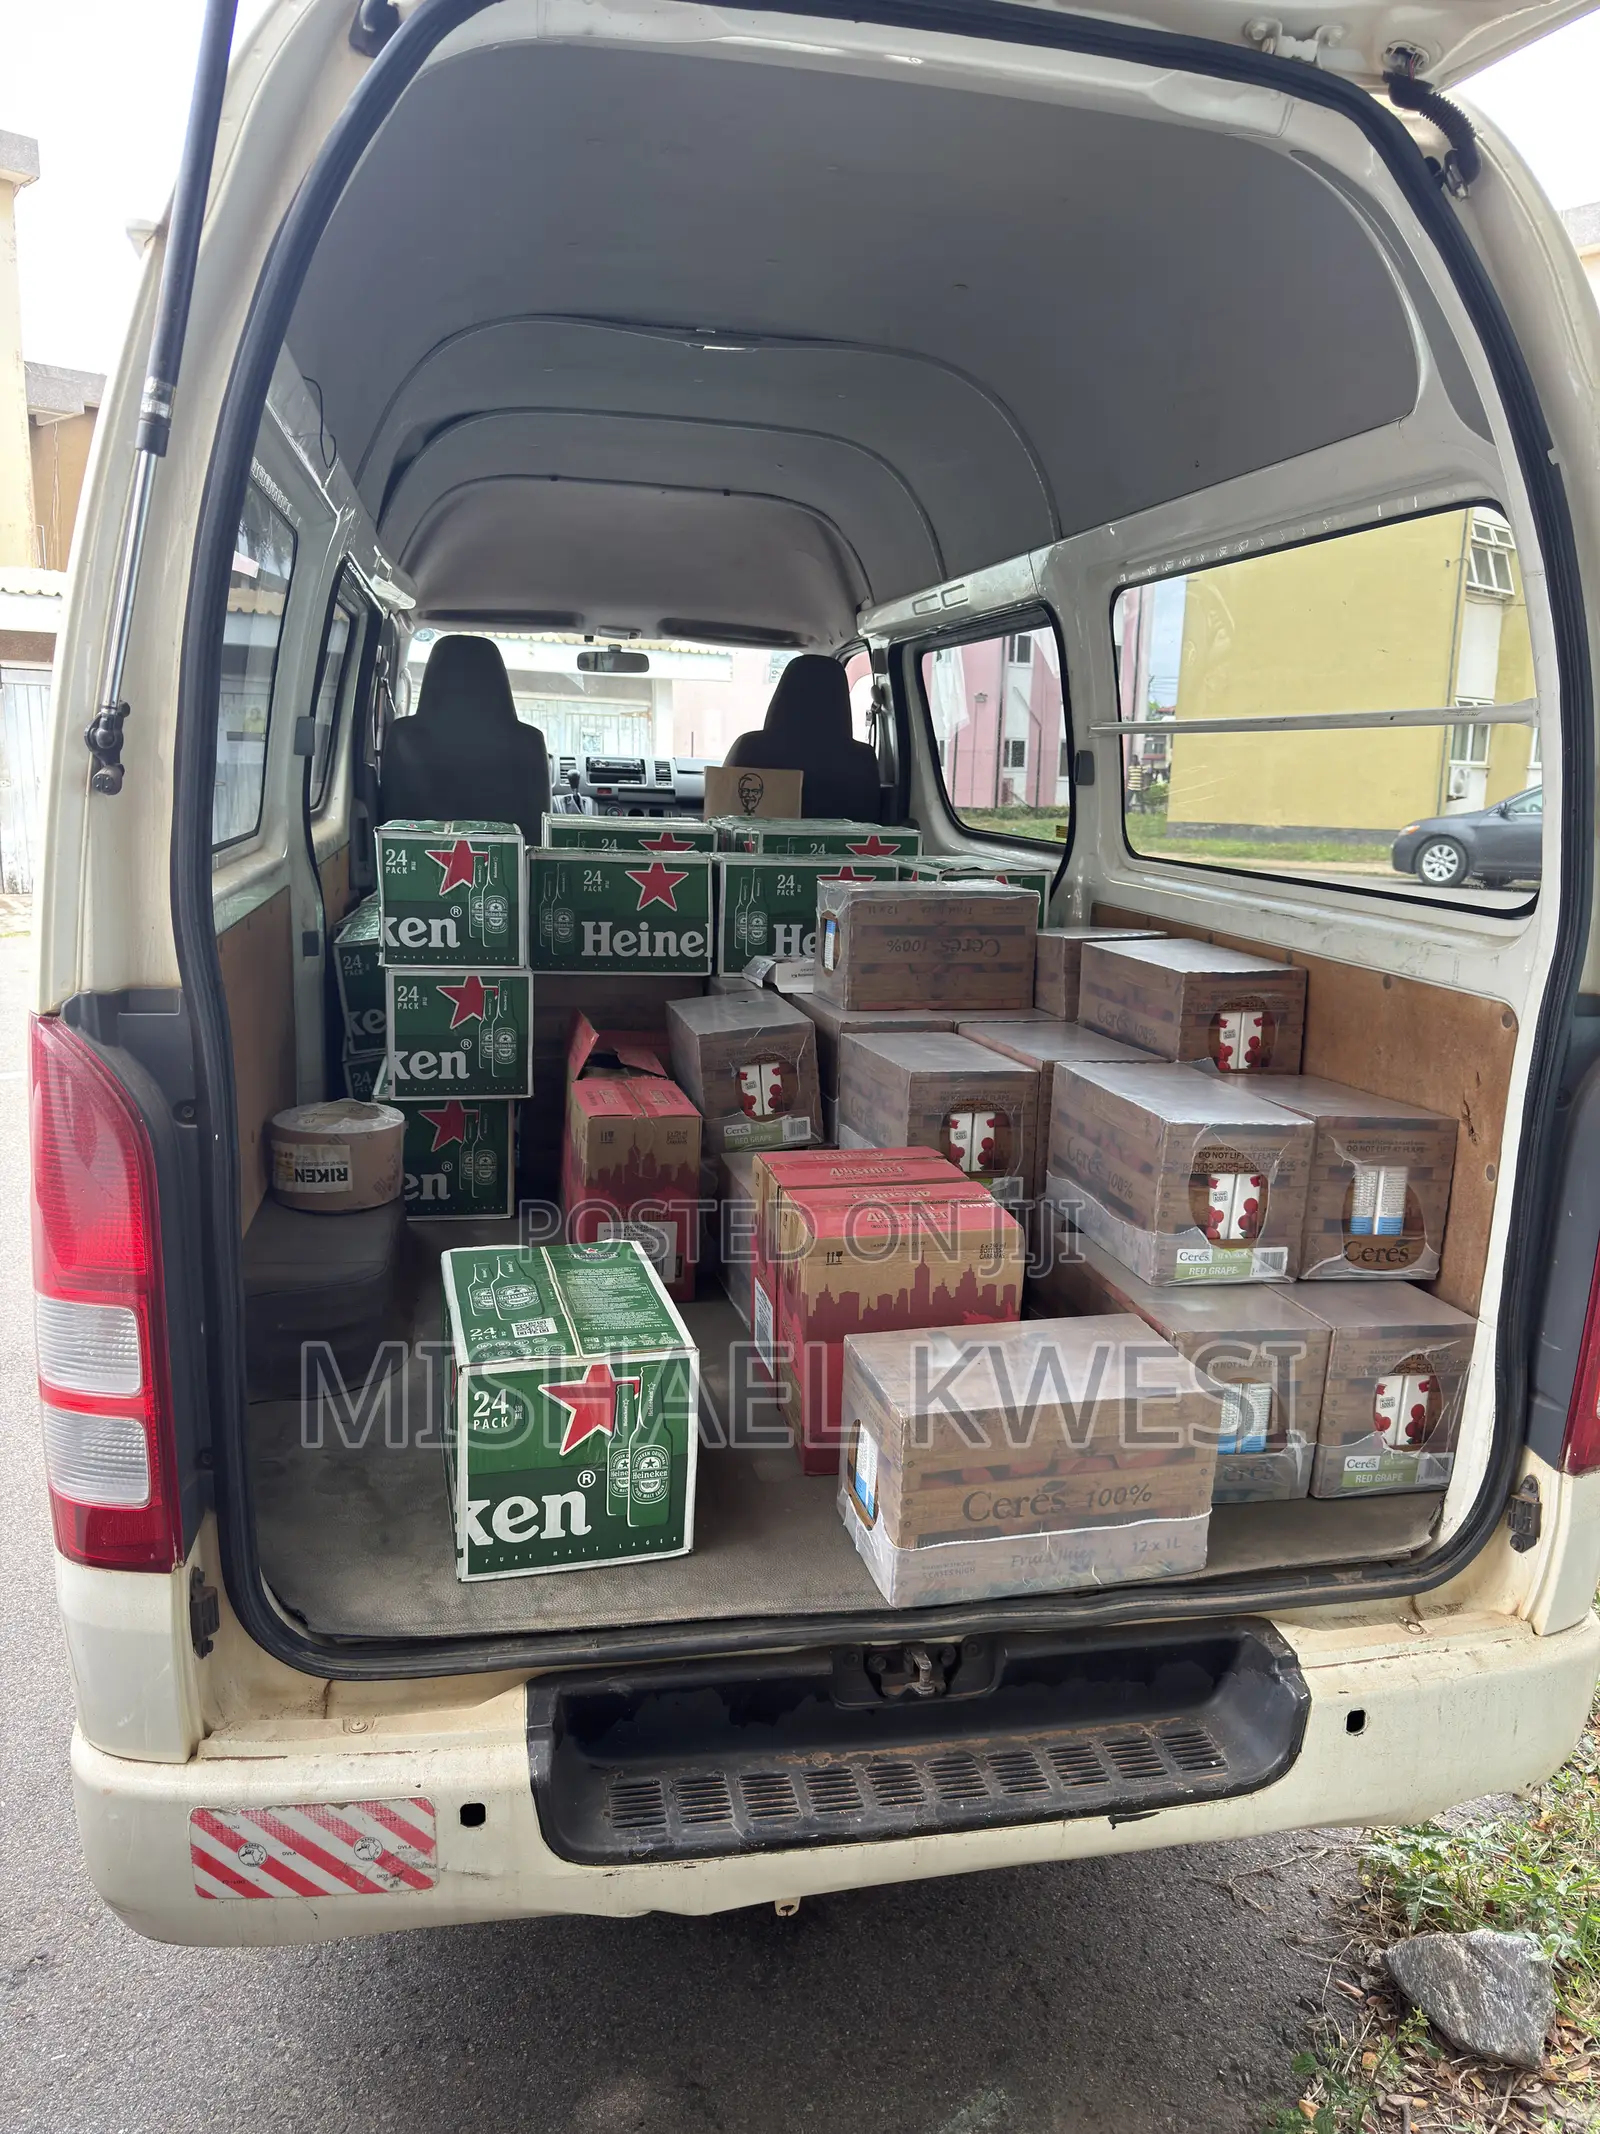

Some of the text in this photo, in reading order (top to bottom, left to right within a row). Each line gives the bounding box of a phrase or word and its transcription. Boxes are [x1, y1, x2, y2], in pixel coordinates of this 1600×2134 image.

[385, 848, 407, 866] 24
[385, 866, 408, 875] PACK
[583, 870, 602, 885] 24
[777, 874, 794, 889] 24
[343, 955, 361, 970] 24
[397, 986, 419, 1001] 24
[398, 1002, 419, 1010] PACK
[353, 1071, 371, 1087] 24
[726, 1126, 750, 1134] Ceres
[295, 1168, 348, 1183] RIKEN
[1179, 1251, 1210, 1261] Ceres
[1344, 1240, 1409, 1263] Ceres
[1189, 1266, 1237, 1275] RED GRAPE
[469, 1327, 497, 1337] 24
[473, 1389, 509, 1417] 24
[473, 1416, 508, 1430] PACK
[1346, 1458, 1377, 1469] Ceres
[632, 1470, 668, 1479] Heineken
[1356, 1473, 1403, 1483] RED GRAPE
[962, 1483, 1152, 1522] Ceres 100%
[485, 1536, 677, 1564] PURE MALT LAGER
[1132, 1539, 1147, 1551] 12
[1166, 1537, 1181, 1550] 1L
